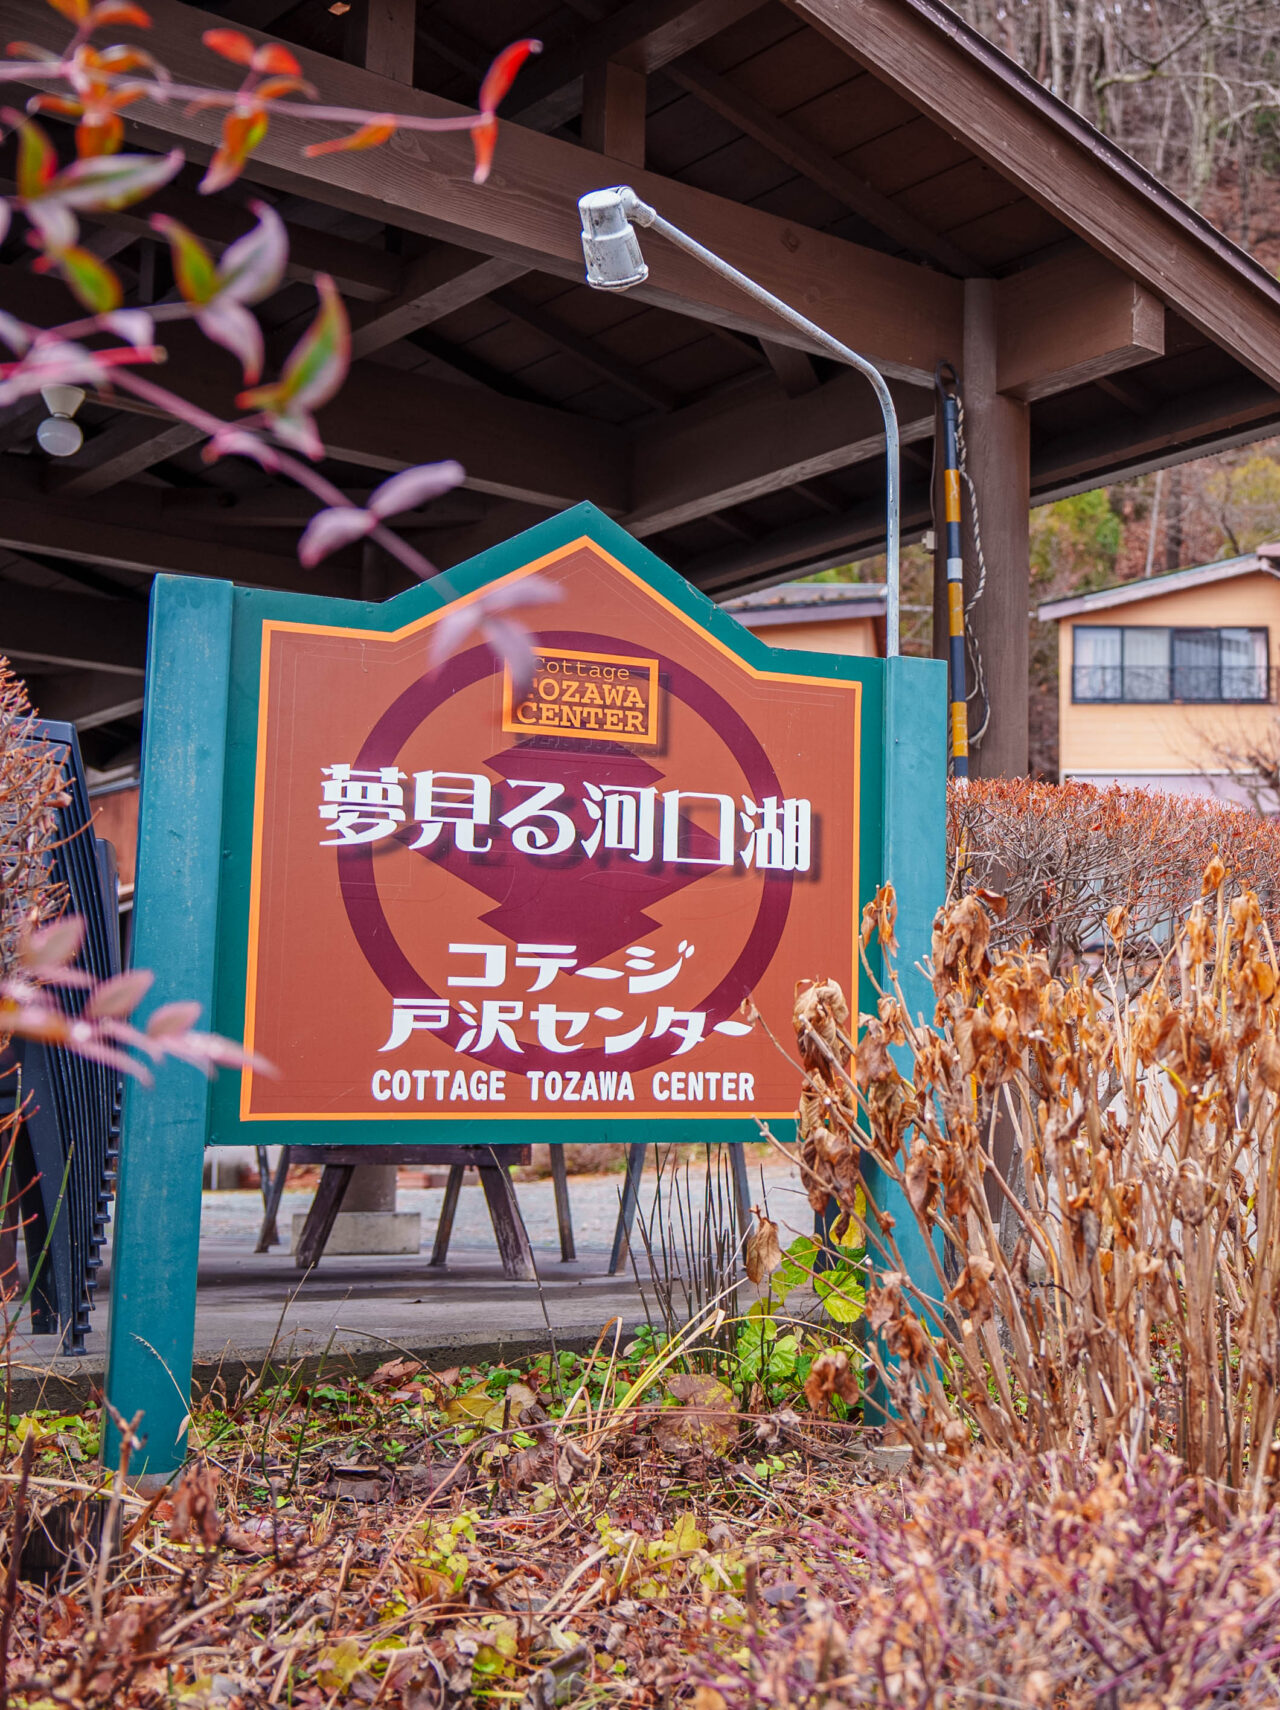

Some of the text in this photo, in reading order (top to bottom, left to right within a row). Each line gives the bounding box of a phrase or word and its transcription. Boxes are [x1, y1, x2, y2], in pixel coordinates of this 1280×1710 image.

[534, 657, 630, 682] Cottage
[527, 678, 646, 708] OZAWA
[516, 702, 646, 732] CENTER
[319, 763, 812, 872] 夢見る河口湖
[447, 939, 695, 994] コテージ
[378, 998, 754, 1056] 戸沢センター
[371, 1069, 755, 1102] COTTAGE TOZAWA CENTER
